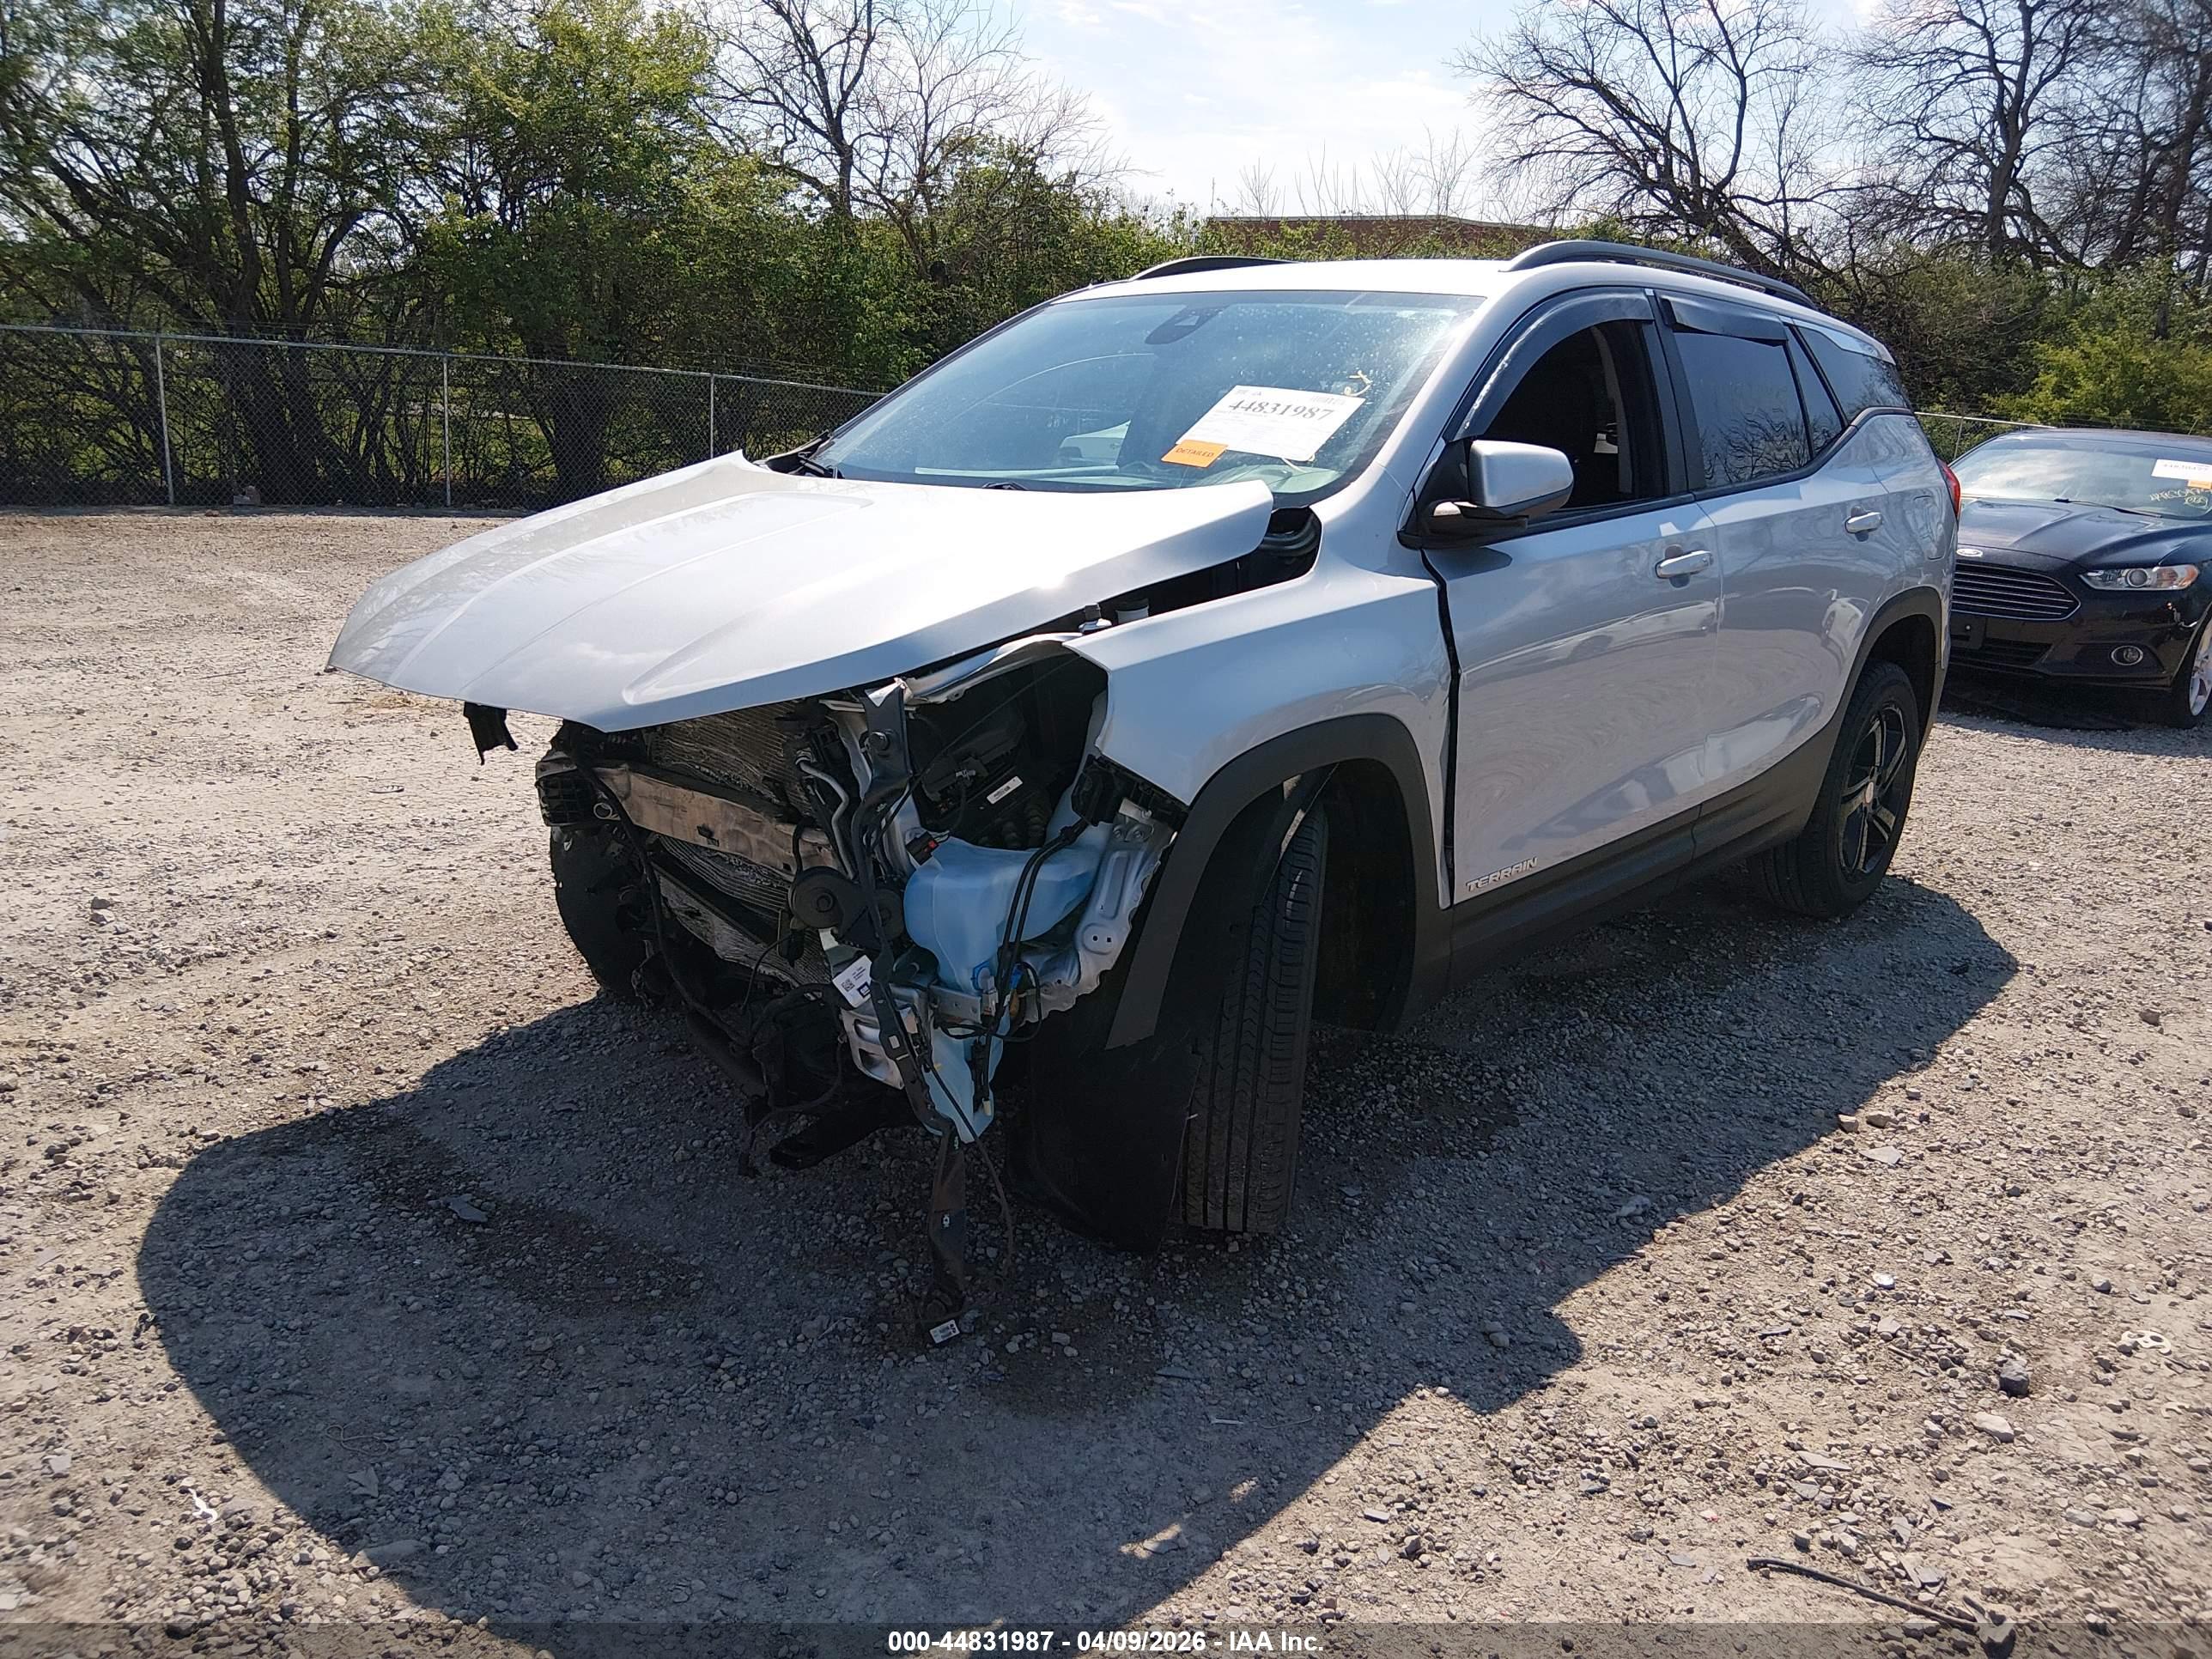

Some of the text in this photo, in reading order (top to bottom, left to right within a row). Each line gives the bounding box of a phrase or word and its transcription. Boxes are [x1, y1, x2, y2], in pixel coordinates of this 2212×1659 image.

[1228, 399, 1335, 421] 44831987
[1175, 447, 1214, 458] DETAILED
[1466, 855, 1539, 892] TERRAIN
